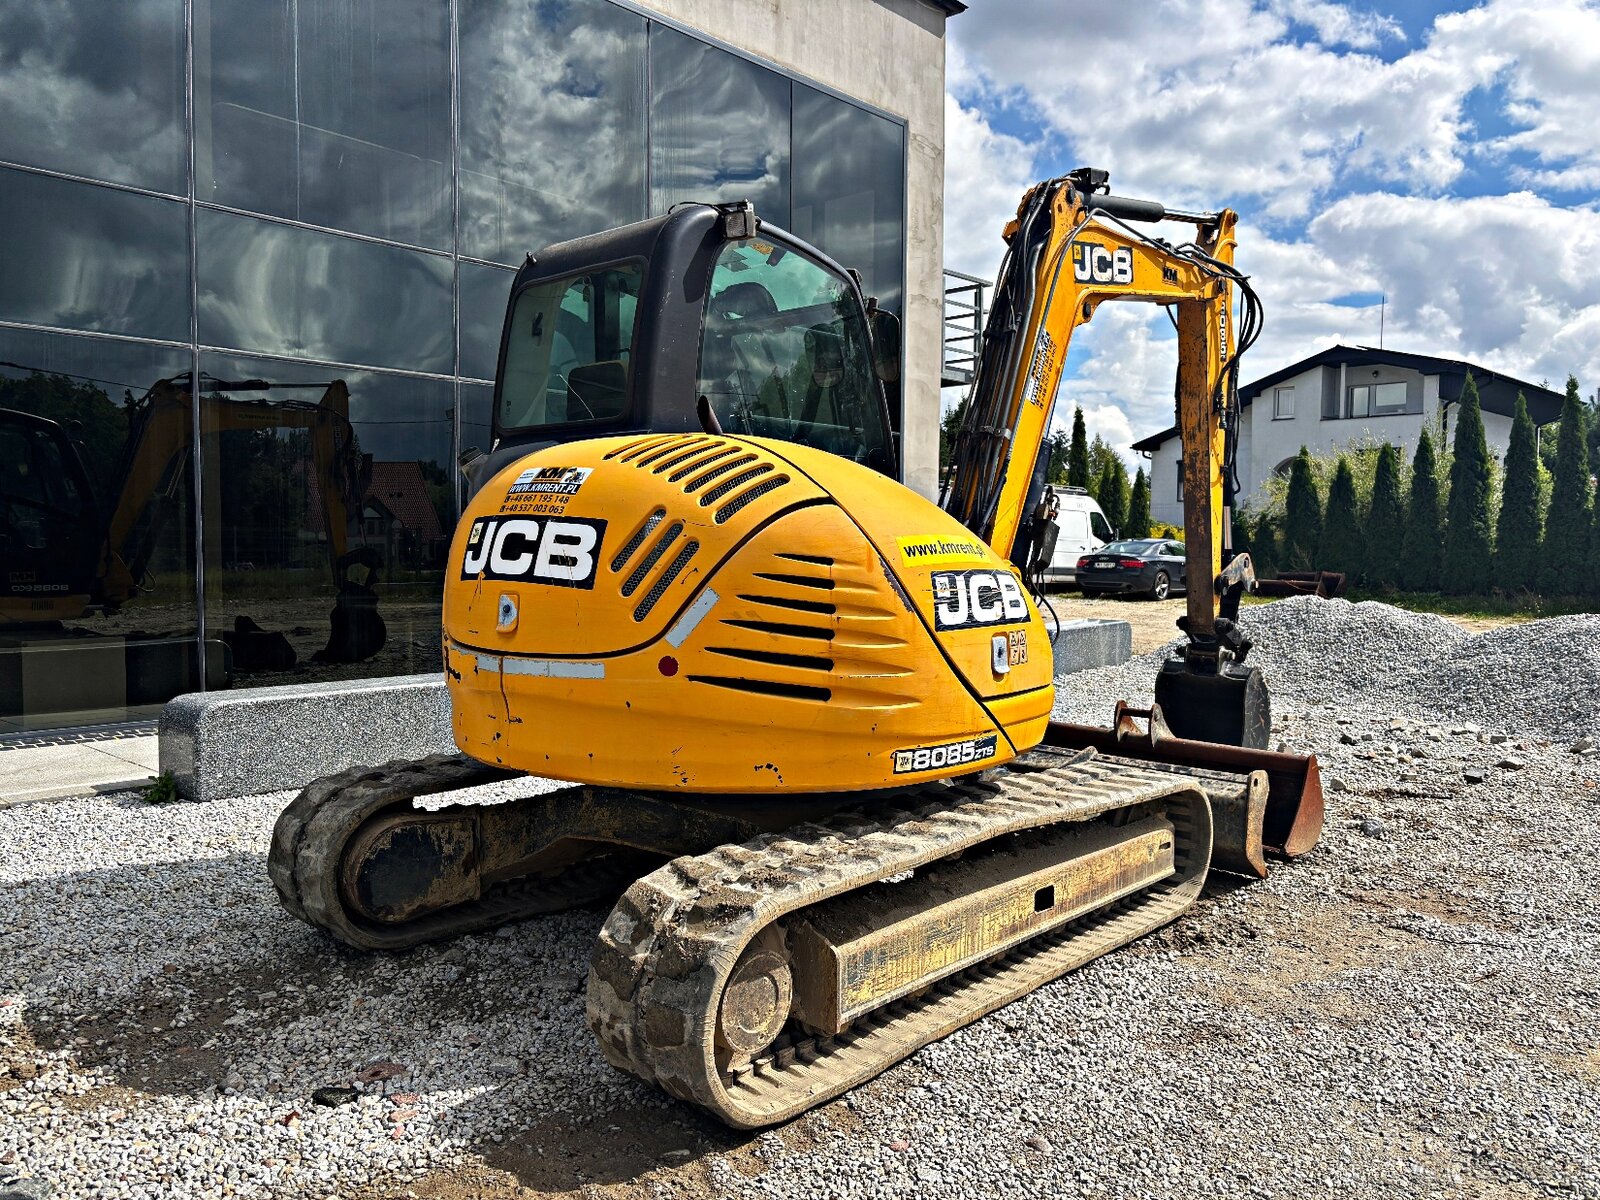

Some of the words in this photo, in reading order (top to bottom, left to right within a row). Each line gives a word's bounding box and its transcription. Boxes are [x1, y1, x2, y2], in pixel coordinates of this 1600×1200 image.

[1074, 244, 1132, 284] JCB
[536, 467, 567, 478] KM
[509, 483, 578, 494] WWW.KMRENT.PL
[539, 495, 552, 503] 195
[554, 496, 570, 504] 148
[518, 504, 532, 512] 537
[533, 505, 548, 513] 003
[548, 506, 565, 514] 063
[464, 519, 597, 581] JCB
[903, 540, 986, 558] www.kmrent.pl
[937, 573, 1028, 626] JCB
